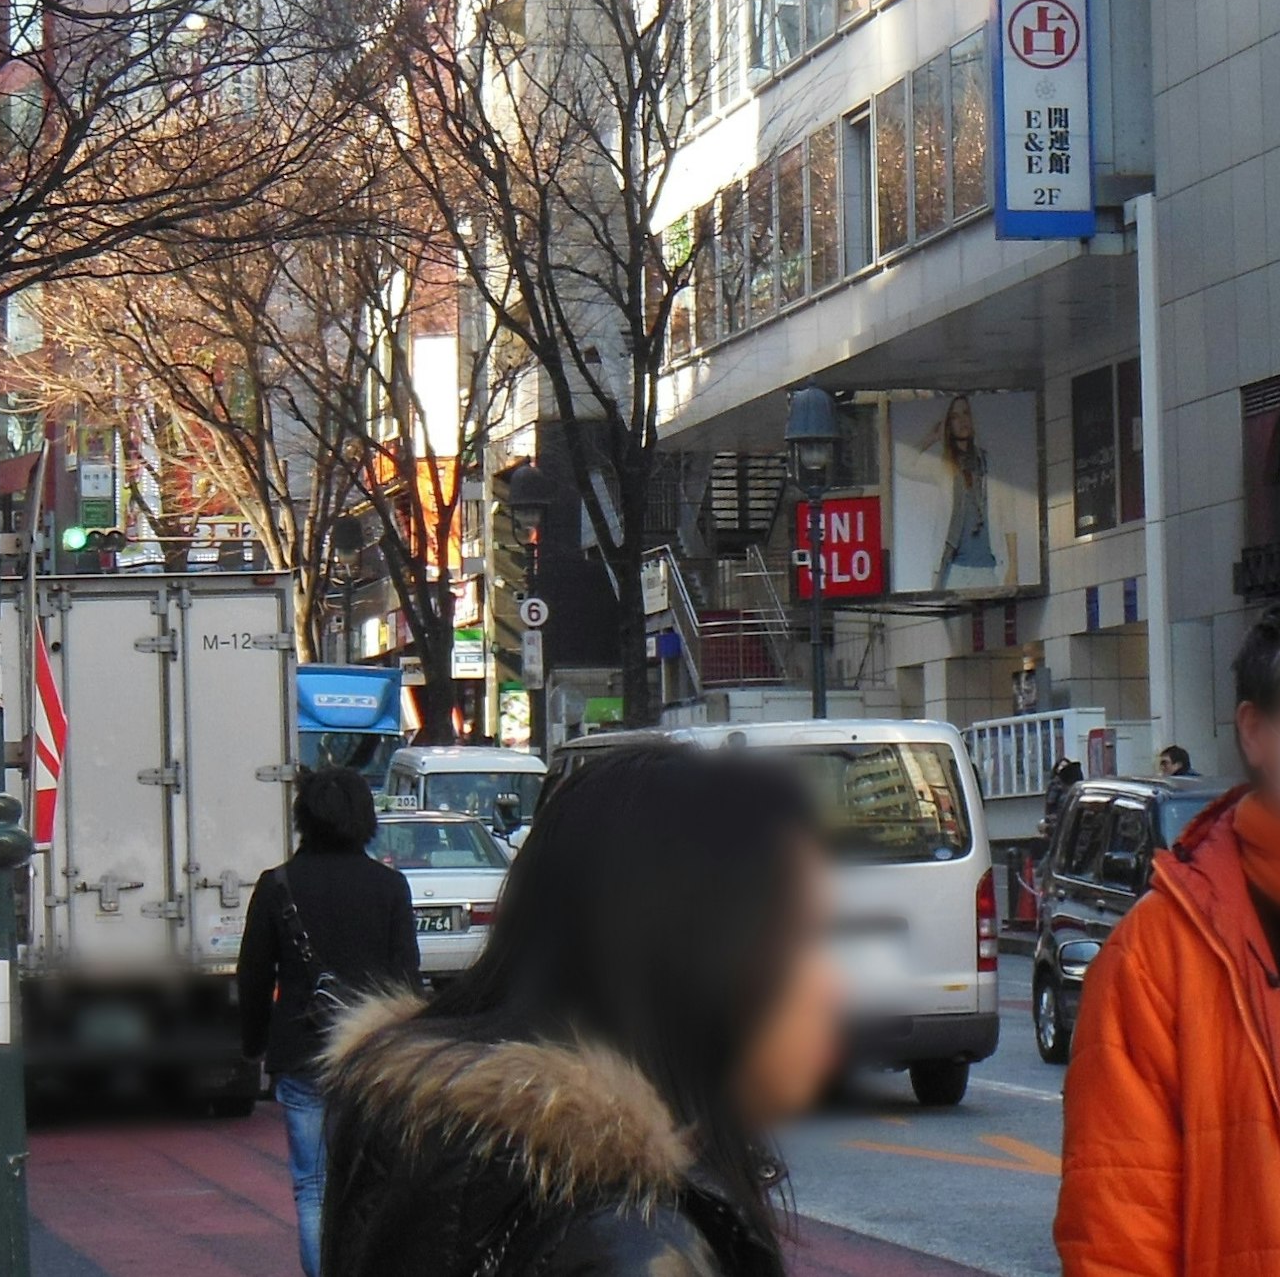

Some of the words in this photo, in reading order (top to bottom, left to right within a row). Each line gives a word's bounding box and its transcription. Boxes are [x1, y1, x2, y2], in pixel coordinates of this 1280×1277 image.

[1023, 6, 1069, 57] 占
[1047, 107, 1070, 176] 開運館
[1033, 188, 1061, 206] 2F
[526, 601, 542, 623] 6
[396, 796, 417, 807] 202
